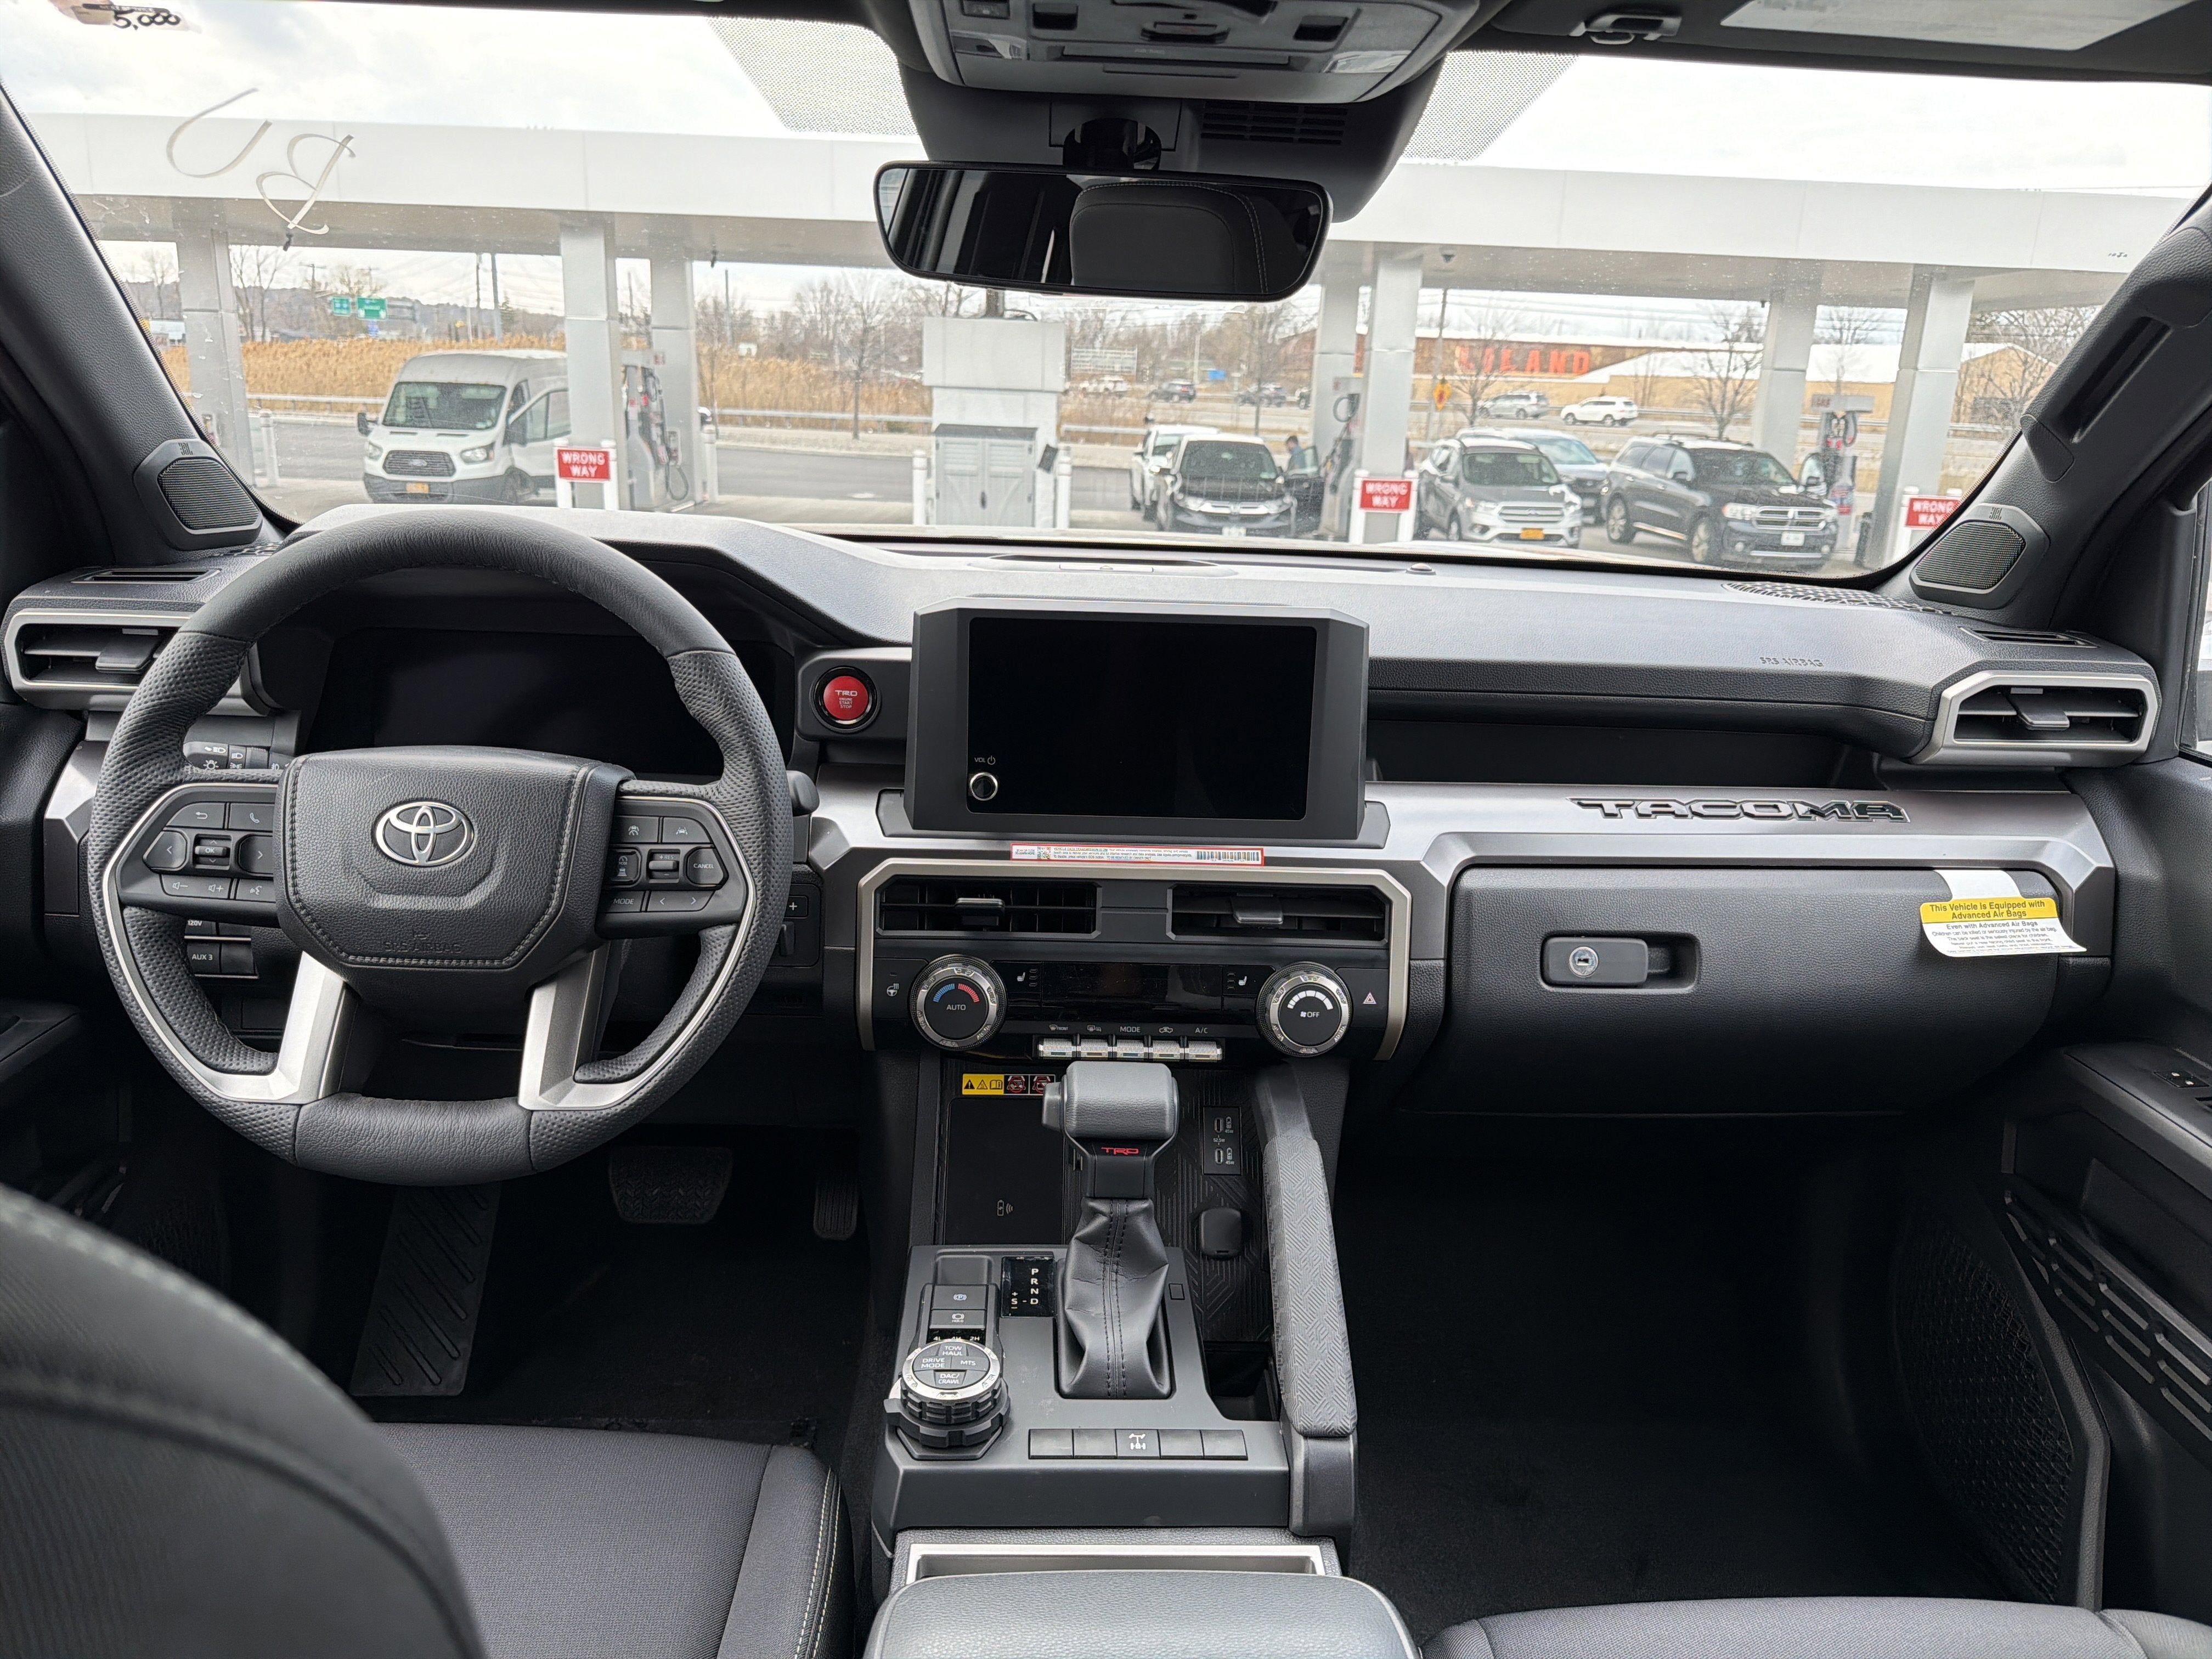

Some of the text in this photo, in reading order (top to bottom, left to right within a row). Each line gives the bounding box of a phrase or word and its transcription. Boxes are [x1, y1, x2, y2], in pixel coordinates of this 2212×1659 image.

[178, 443, 194, 456] JBL
[560, 451, 605, 465] WRONG
[569, 465, 598, 477] WAY
[1365, 483, 1408, 495] WRONG
[1372, 495, 1399, 508] WAY
[1913, 500, 1955, 513] WRONG
[1989, 507, 2003, 521] JBL
[1566, 797, 1910, 823] TACOMA
[1949, 902, 1978, 911] Vehicle
[1989, 901, 2026, 911] Equipped
[1952, 911, 1991, 919] Advanced
[2006, 910, 2027, 918] Bags
[1101, 1147, 1139, 1155] TRD
